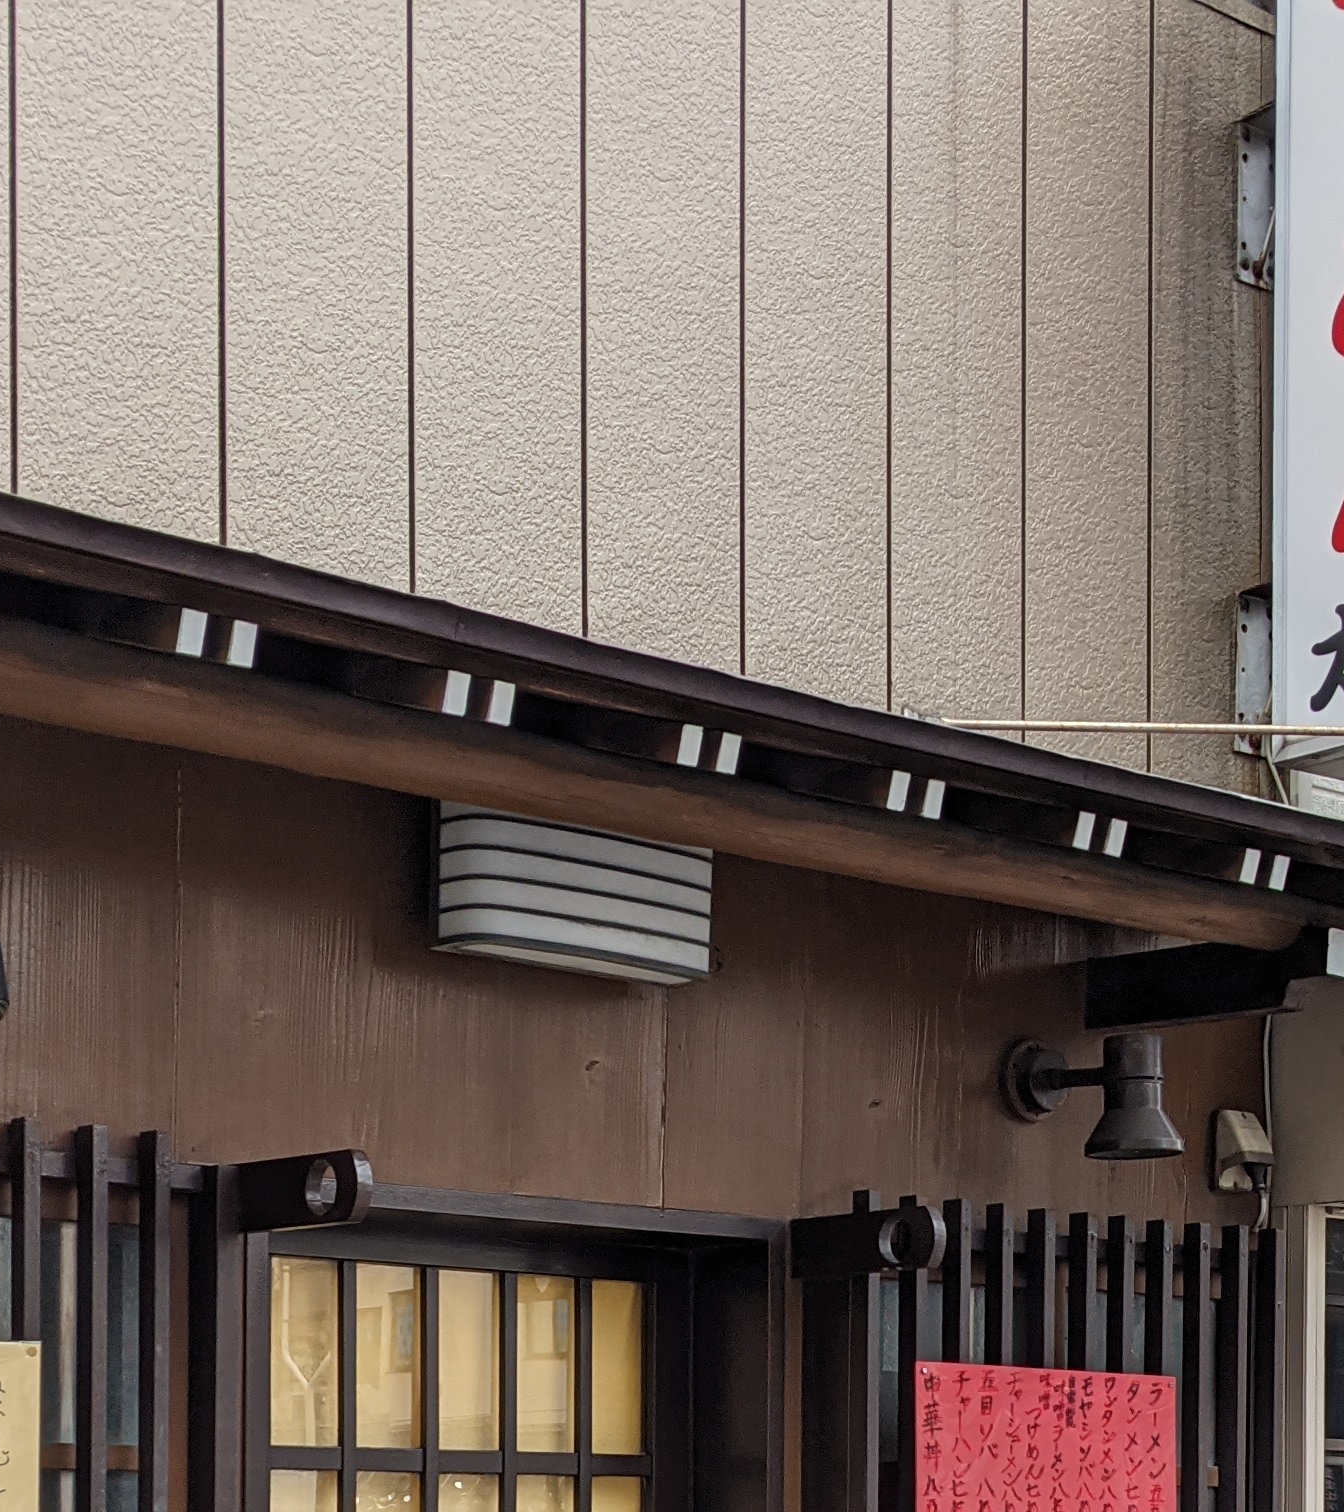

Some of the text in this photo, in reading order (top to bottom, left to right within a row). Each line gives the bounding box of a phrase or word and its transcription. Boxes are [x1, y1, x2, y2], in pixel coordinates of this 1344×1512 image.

[978, 1370, 999, 1460] 五目ソバ
[1025, 1408, 1045, 1480] つけめん
[1077, 1376, 1096, 1481] モヤシソバ
[1100, 1377, 1119, 1482] ワンタンメン
[1124, 1381, 1143, 1477] タンメン
[1146, 1382, 1167, 1480] ラーメン
